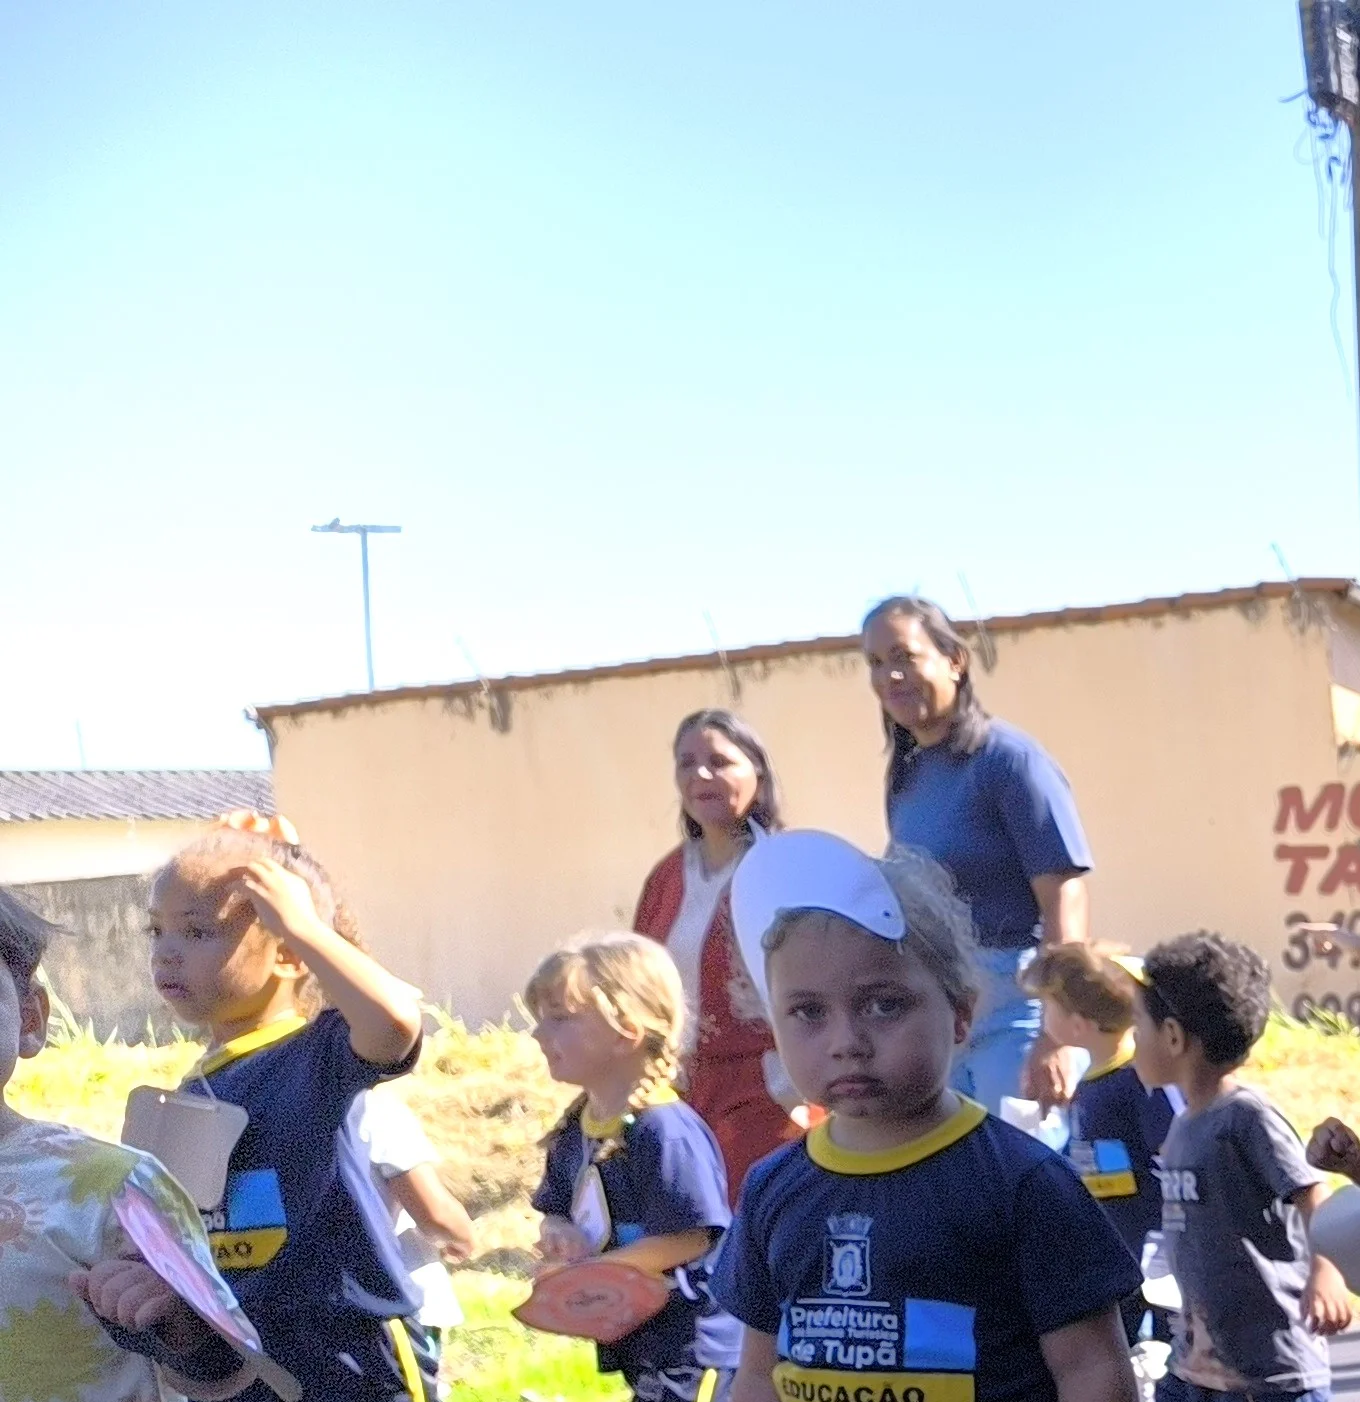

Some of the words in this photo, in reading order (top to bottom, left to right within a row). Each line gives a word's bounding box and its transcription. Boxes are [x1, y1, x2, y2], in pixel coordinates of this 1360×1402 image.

[790, 1306, 898, 1330] Prefeitura
[791, 1339, 816, 1363] de
[822, 1340, 897, 1369] Tupã
